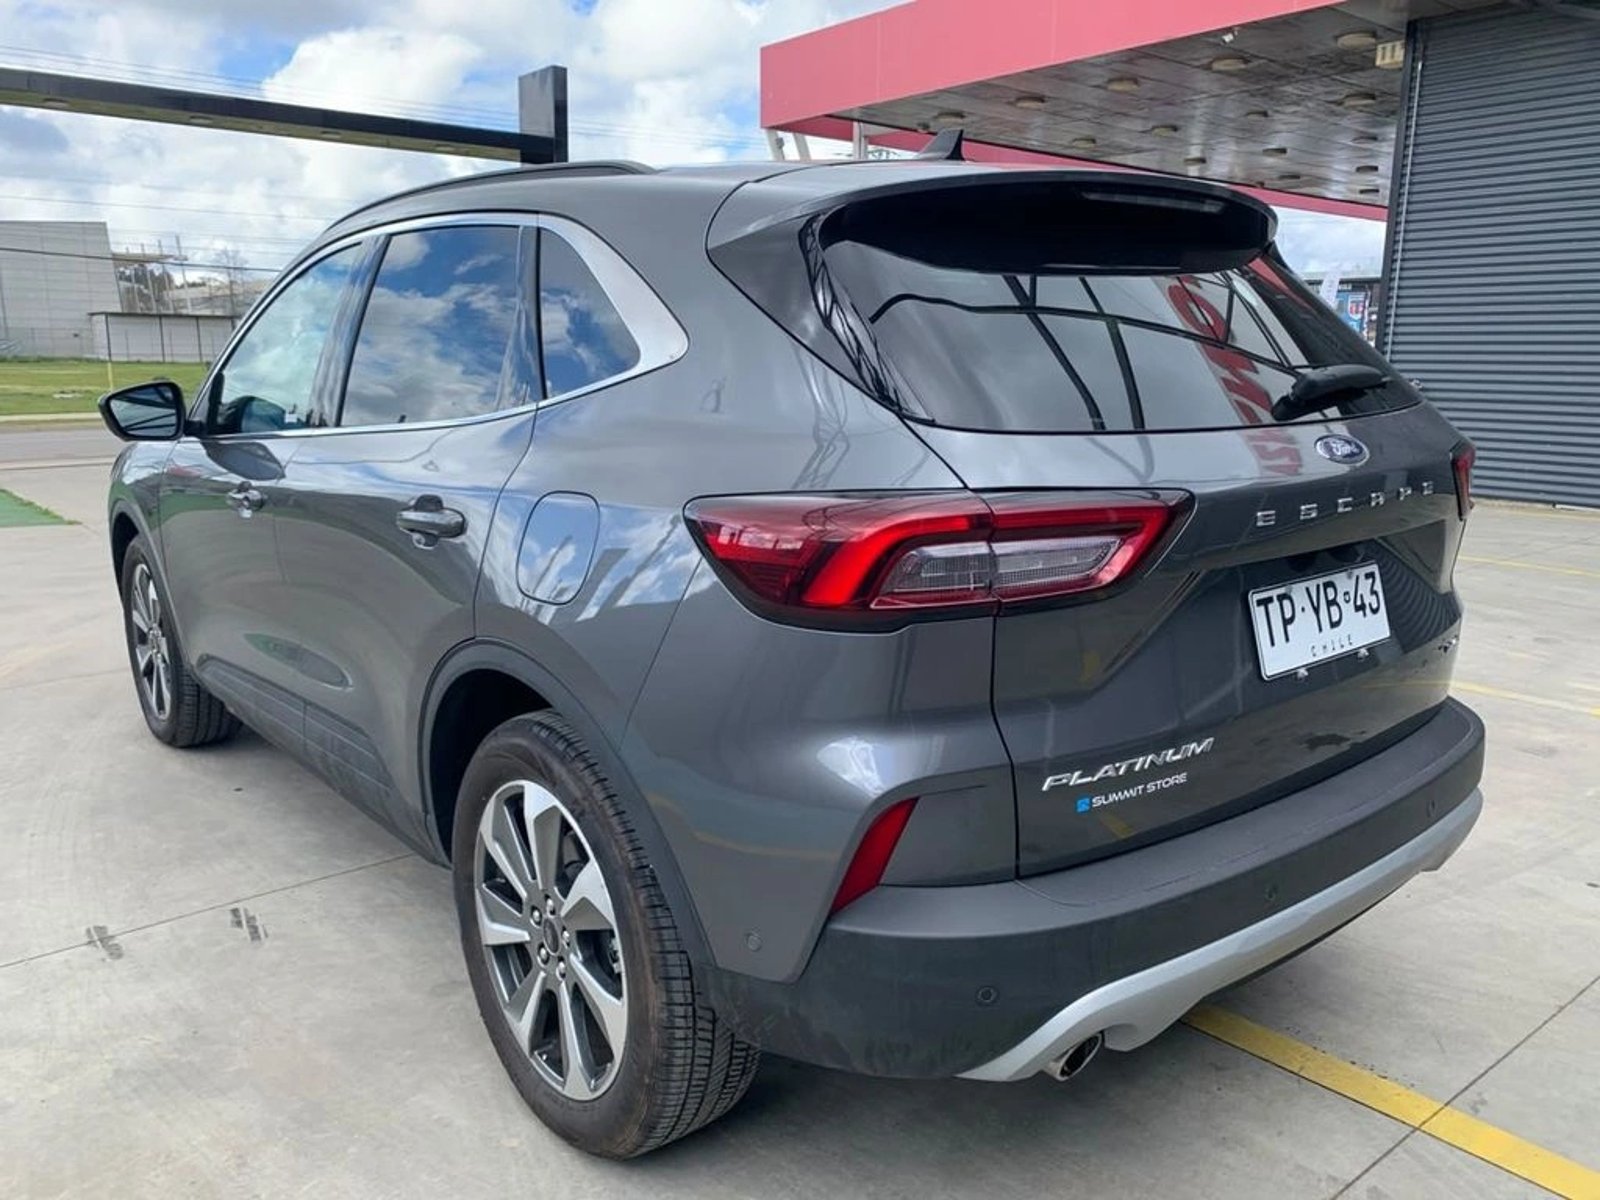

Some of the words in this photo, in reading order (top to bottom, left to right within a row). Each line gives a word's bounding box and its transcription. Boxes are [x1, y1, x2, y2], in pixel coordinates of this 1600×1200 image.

[1256, 480, 1434, 527] ESCAPE
[1041, 737, 1215, 792] PLATINUM
[1091, 784, 1145, 808] SUMMIT
[1146, 772, 1188, 793] STORE
